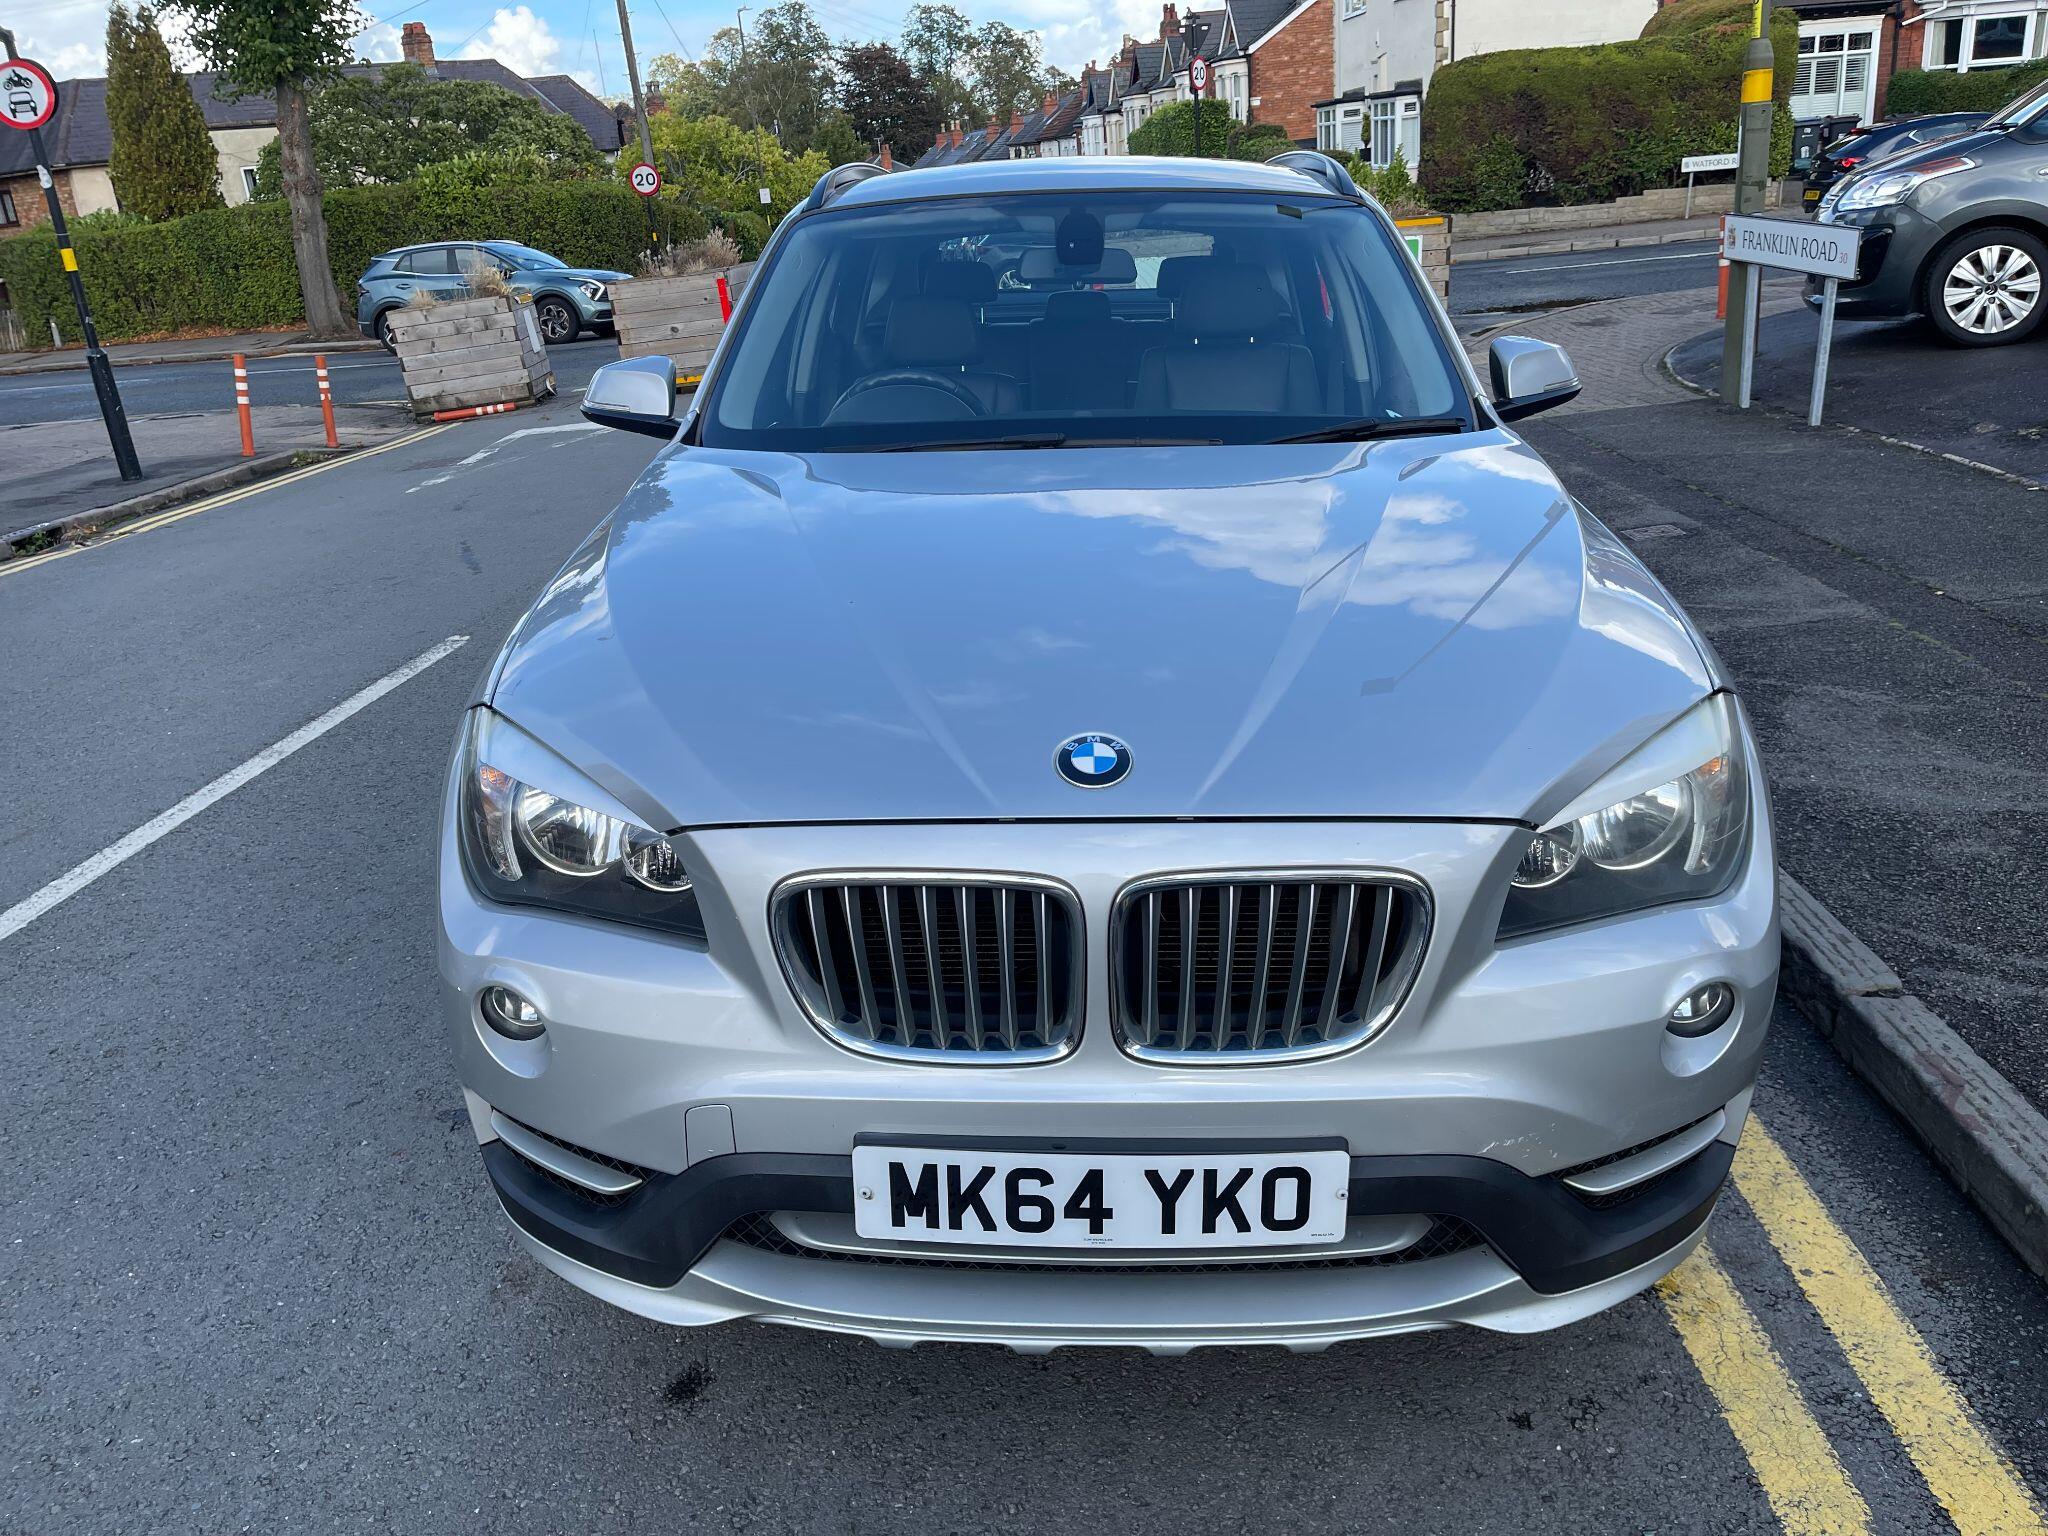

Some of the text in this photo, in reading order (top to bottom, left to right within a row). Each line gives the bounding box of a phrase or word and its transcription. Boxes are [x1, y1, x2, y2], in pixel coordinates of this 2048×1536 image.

[1194, 67, 1205, 80] 20
[1692, 158, 1730, 168] WATFORD
[635, 172, 656, 187] 20
[1742, 230, 1848, 264] FRANKLIN ROAD 30
[1065, 736, 1126, 751] BMW
[888, 1161, 1312, 1235] MK64 YKO
